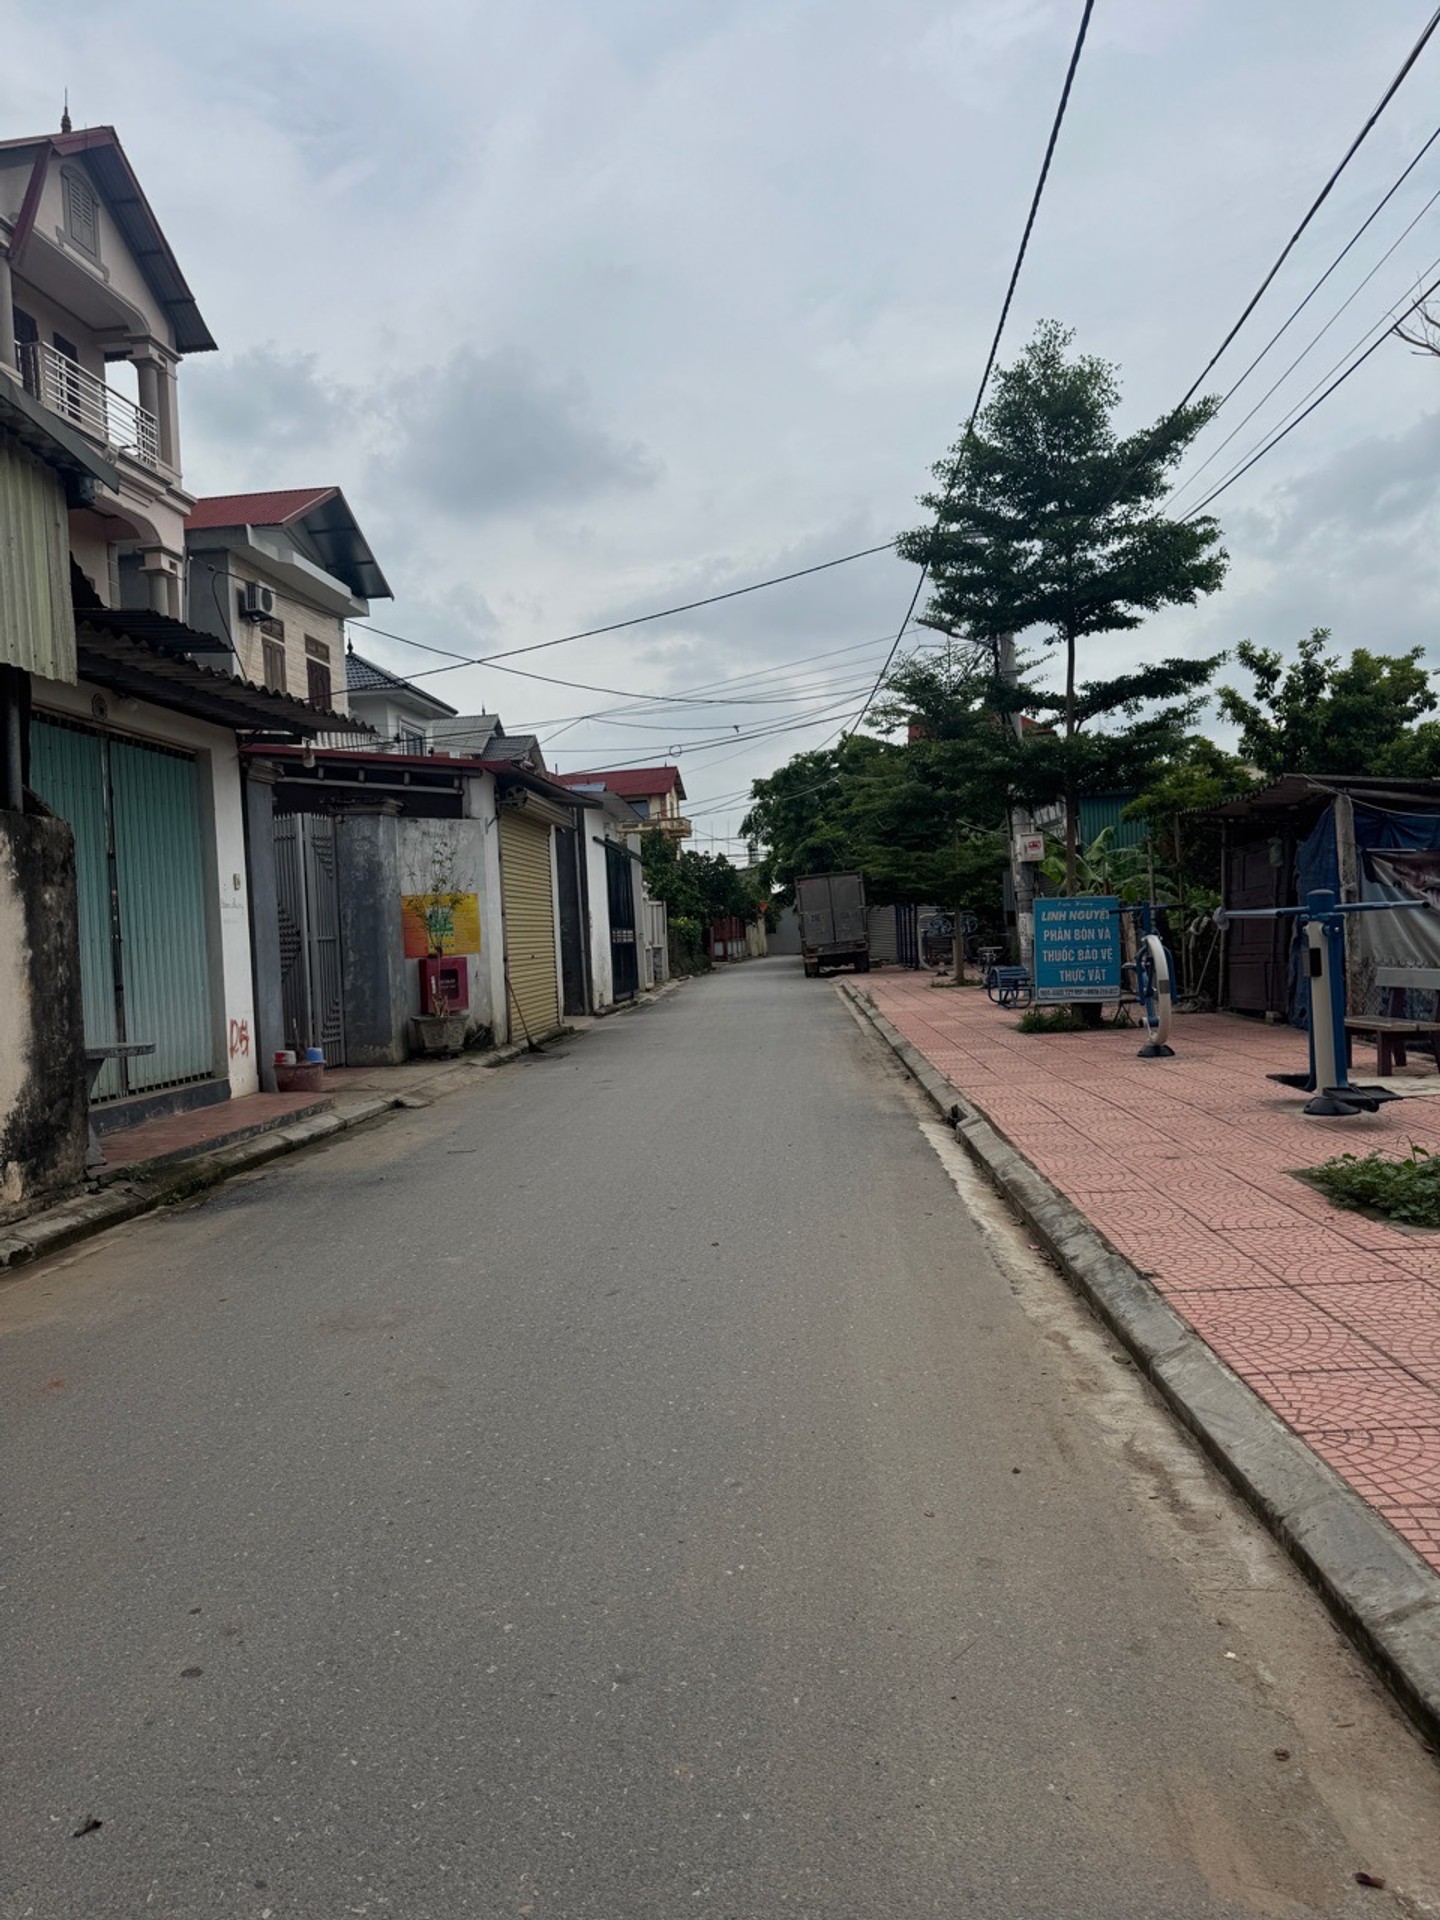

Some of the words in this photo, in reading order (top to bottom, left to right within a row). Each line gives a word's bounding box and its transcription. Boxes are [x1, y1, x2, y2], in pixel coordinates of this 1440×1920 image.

[1042, 911, 1066, 921] LINH
[1044, 926, 1071, 941] PHÂN
[1074, 925, 1095, 941] BÓN
[1098, 925, 1111, 940] VÀ
[1043, 945, 1074, 962] THUỐC
[1078, 945, 1097, 960] BẢO
[1101, 944, 1113, 963] VỆ
[1060, 968, 1085, 984] THỰC
[1088, 967, 1106, 983] VẬT
